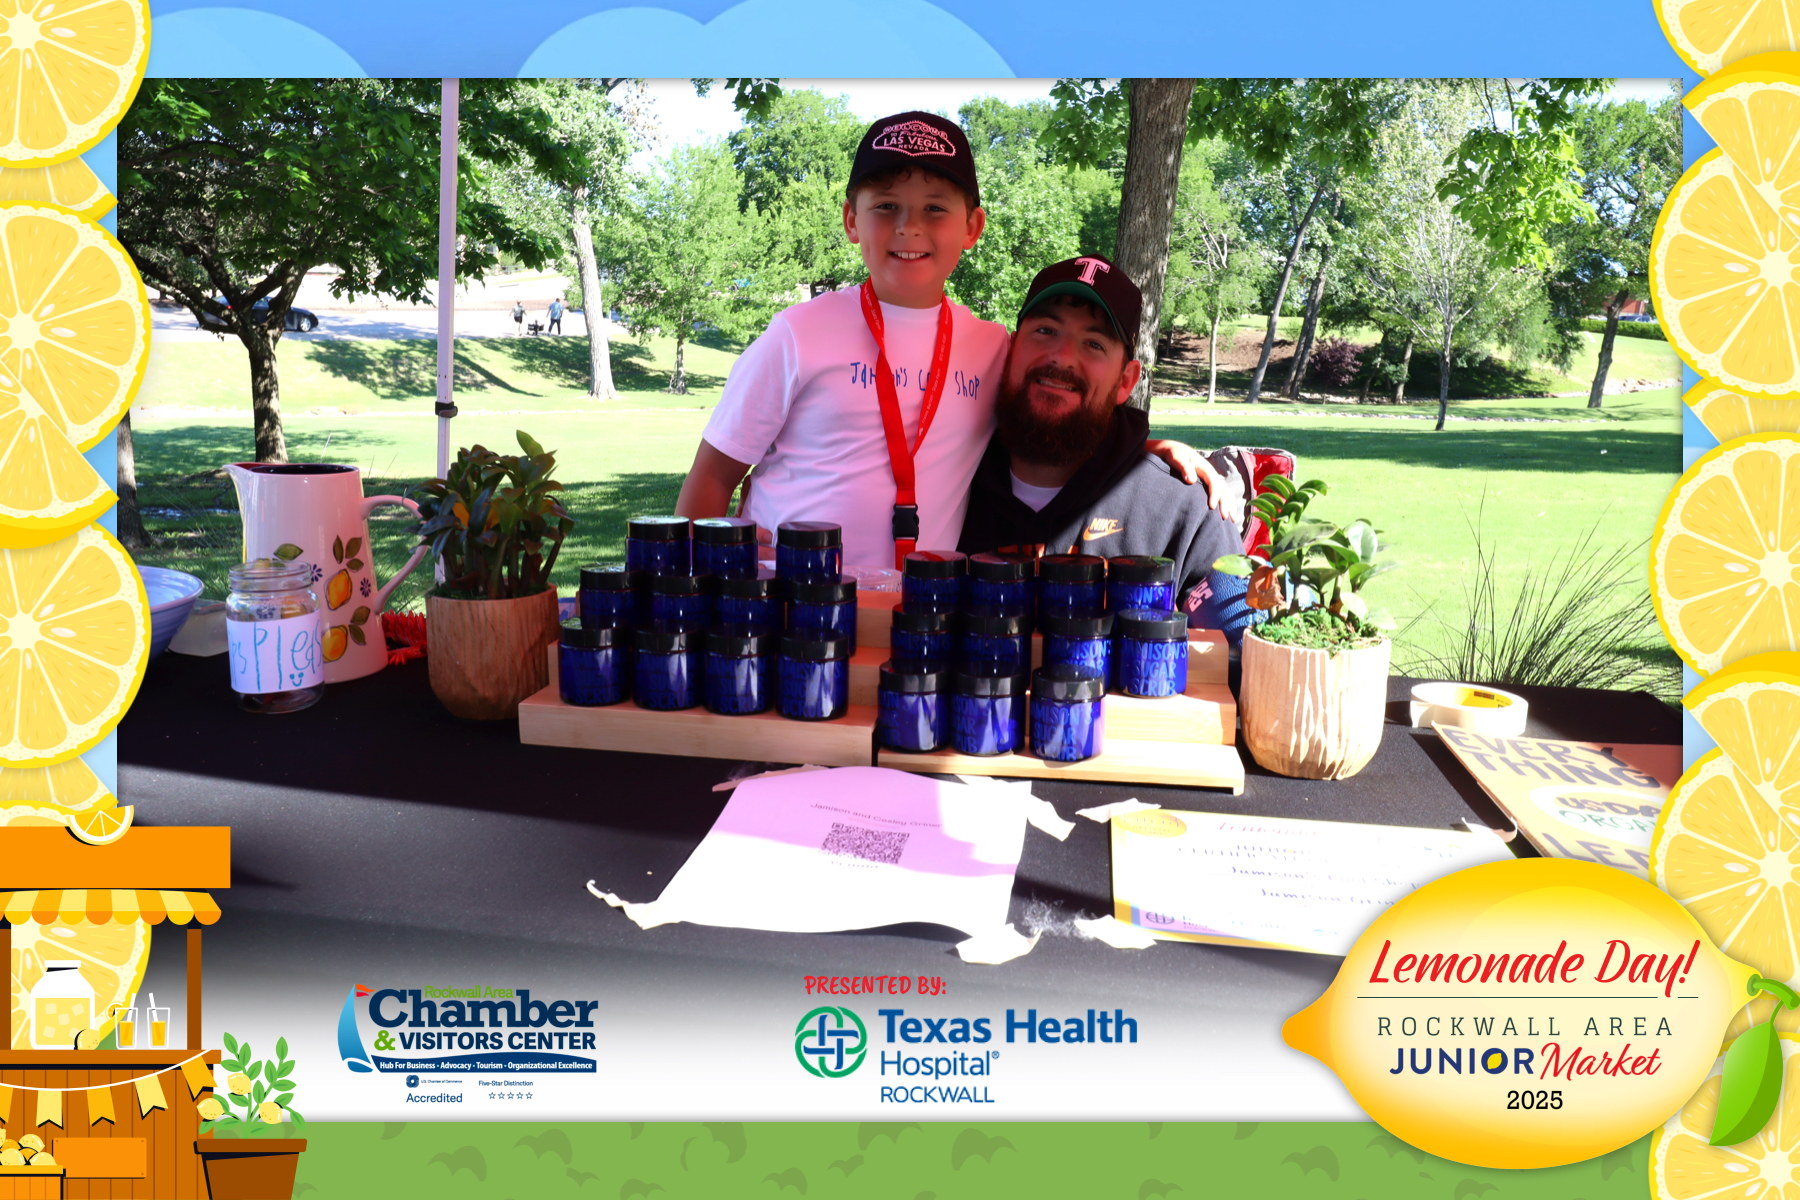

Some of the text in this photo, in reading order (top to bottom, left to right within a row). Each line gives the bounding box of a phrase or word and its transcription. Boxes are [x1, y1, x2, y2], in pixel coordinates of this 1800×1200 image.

[884, 124, 948, 139] WELCOME
[883, 137, 946, 152] LAS VEGAS
[1074, 257, 1111, 287] T
[1090, 518, 1118, 531] NIKE
[1132, 661, 1177, 680] SUGAR
[1131, 678, 1177, 698] SCRUB
[1442, 728, 1628, 767] EVERY
[1459, 749, 1661, 788] THING
[810, 803, 851, 815] Jamison
[852, 812, 872, 820] and
